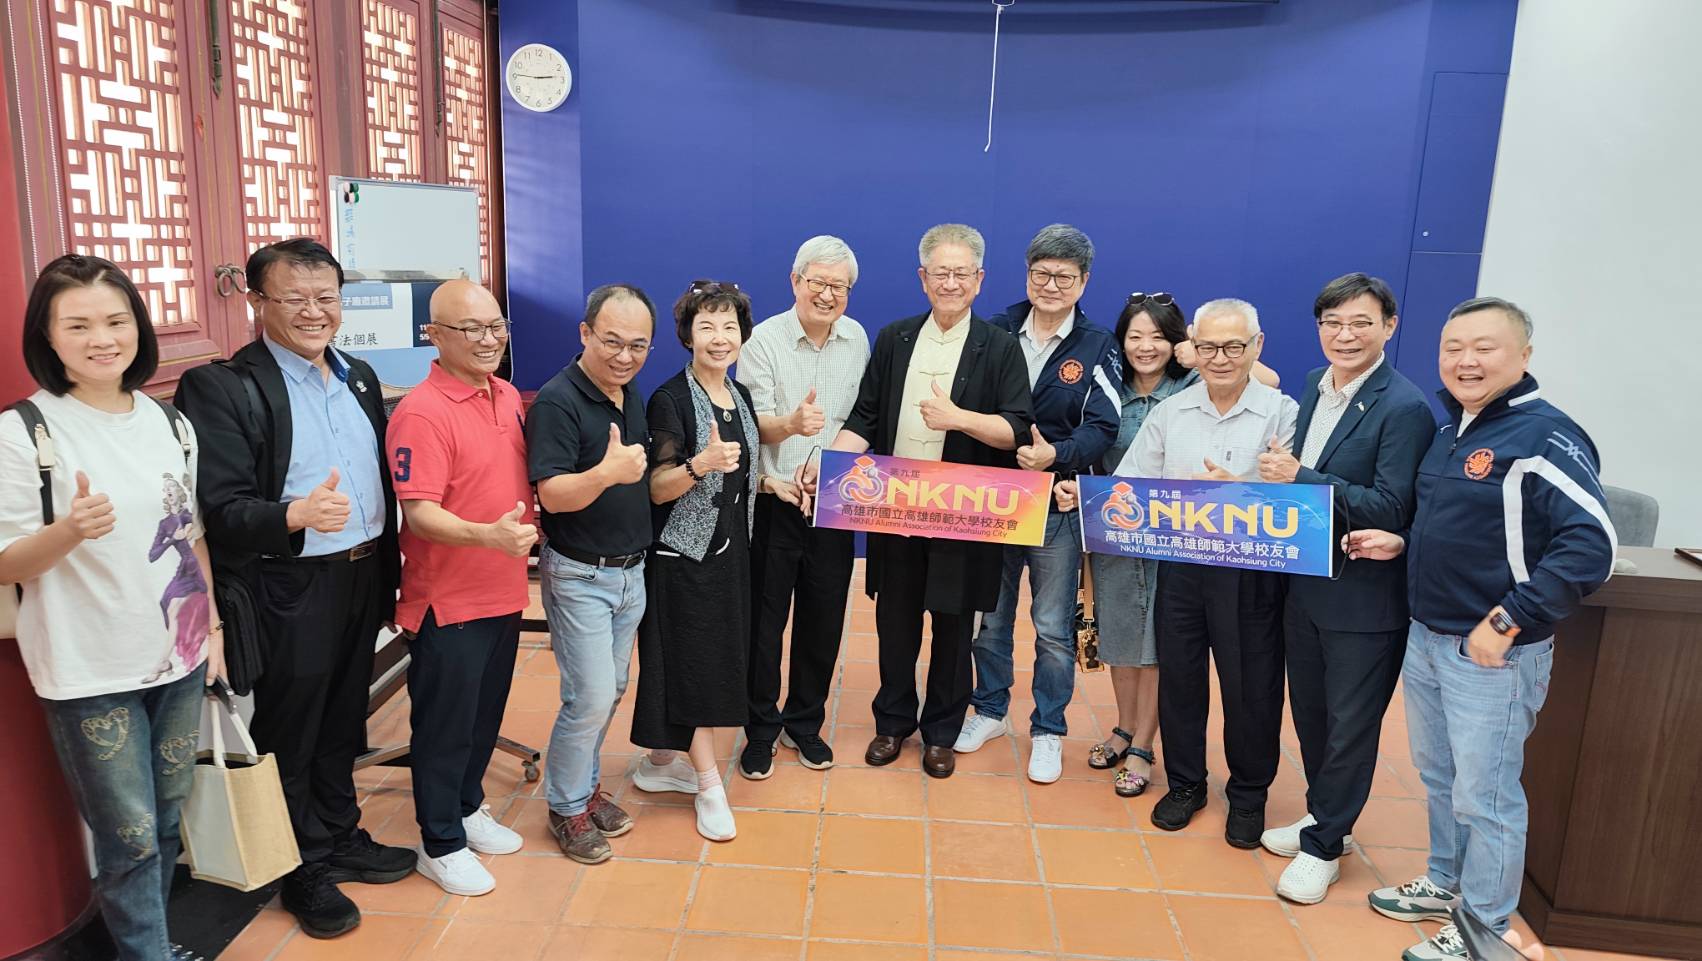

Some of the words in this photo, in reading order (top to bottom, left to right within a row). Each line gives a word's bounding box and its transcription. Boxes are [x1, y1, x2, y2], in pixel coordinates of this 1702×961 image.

[524, 52, 531, 60] 11
[535, 49, 543, 57] 12
[514, 61, 522, 69] 10
[560, 76, 565, 84] 3
[547, 97, 553, 105] 5
[394, 447, 412, 482] 3
[890, 468, 920, 478] 第九屆
[886, 477, 1020, 516] NKNU
[1148, 489, 1182, 500] 第九屆
[841, 504, 1018, 531] 高雄市國立高雄師範大學校友會
[1148, 499, 1299, 538] NKNU
[849, 517, 874, 526] NKNU
[875, 519, 901, 528] Alumni
[902, 522, 943, 532] Association
[943, 525, 952, 533] of
[953, 527, 990, 537] Kaohsiung
[992, 530, 1008, 538] City
[1104, 530, 1300, 560] 高雄市國立高雄師範大學校友會
[1120, 545, 1144, 554] NKNU
[1145, 547, 1172, 557] Alumni
[1173, 550, 1216, 561] Association
[1216, 554, 1225, 562] of
[1226, 554, 1268, 568] Kaohsiung
[1269, 559, 1287, 569] City
